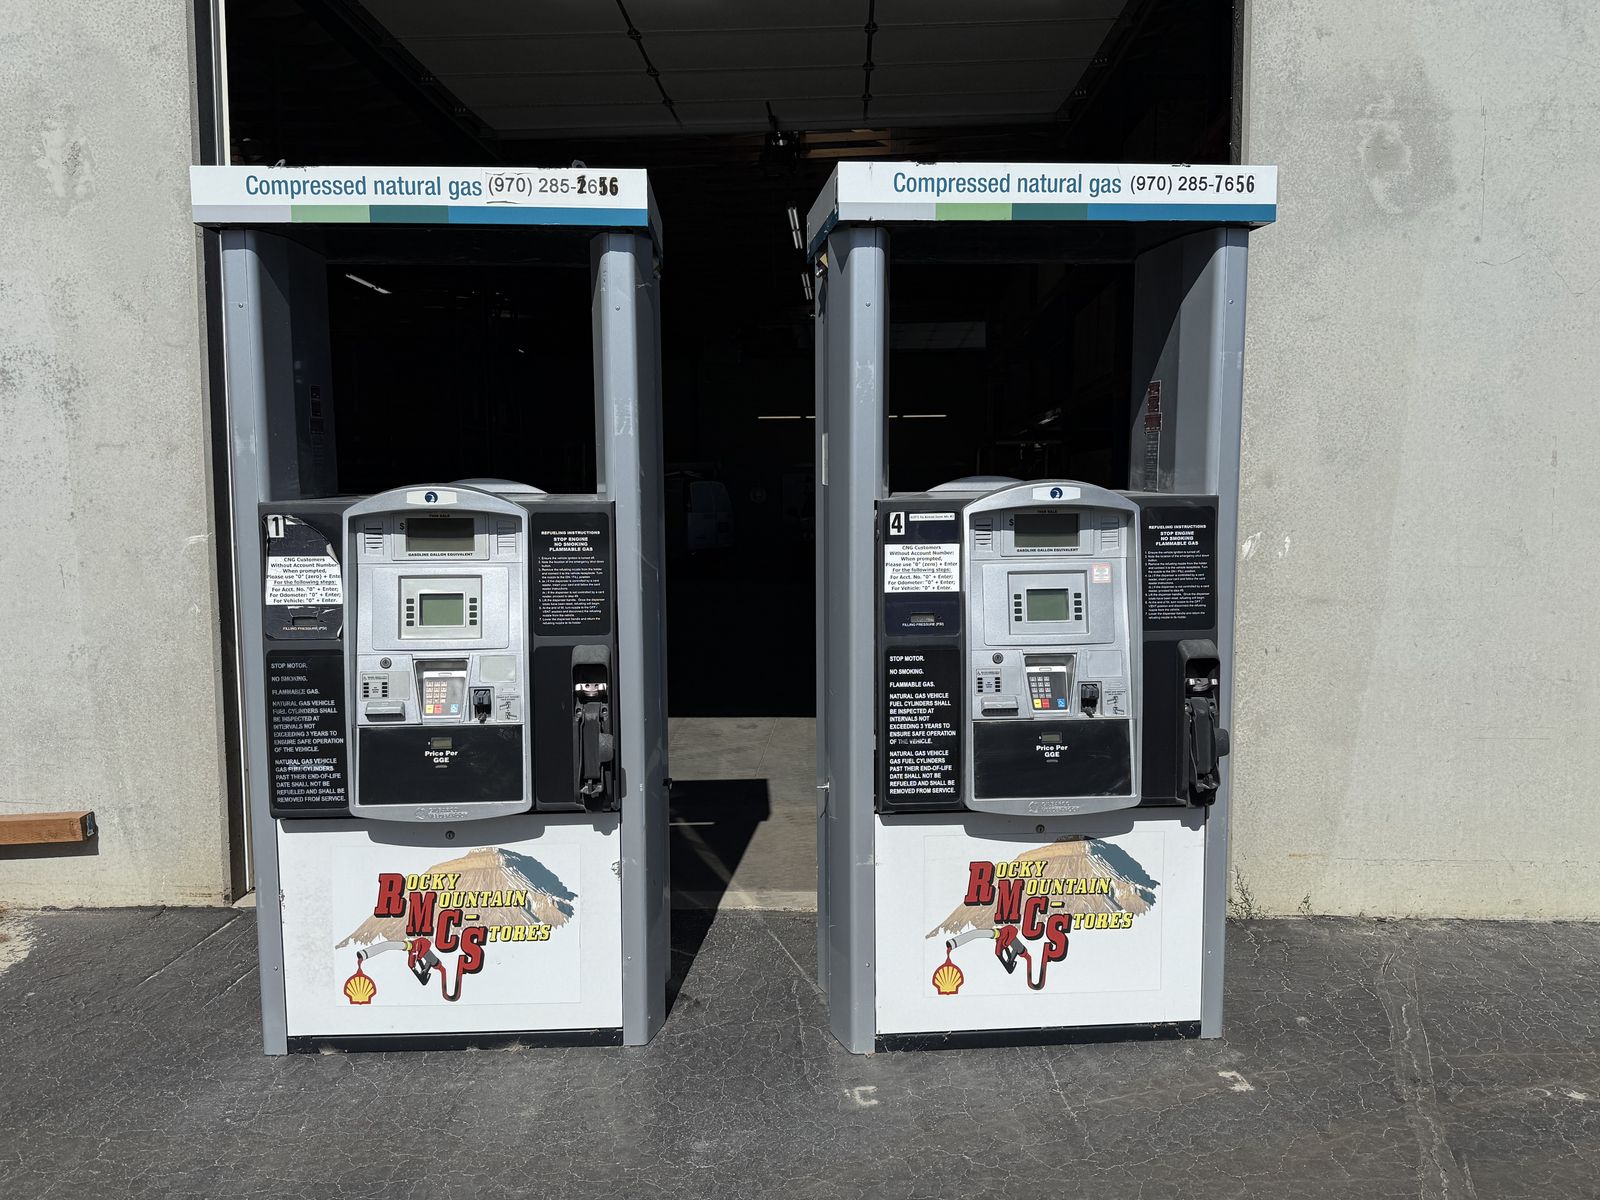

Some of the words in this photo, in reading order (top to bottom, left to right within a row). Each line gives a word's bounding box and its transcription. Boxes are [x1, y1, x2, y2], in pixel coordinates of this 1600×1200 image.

[246, 175, 366, 199] Compressed
[374, 176, 441, 196] natural
[448, 181, 482, 200] gas
[487, 177, 534, 196] (970)
[893, 172, 1011, 197] Compressed
[1017, 174, 1082, 194] natural
[1089, 178, 1121, 198] gas
[1130, 175, 1172, 194] (970)
[1178, 175, 1255, 193] 285-7656
[272, 517, 279, 536] 1
[892, 514, 902, 533] 4
[374, 873, 461, 918] ROCKY
[964, 860, 1048, 906] ROCKY
[994, 877, 1111, 924] MOUNTAIN
[406, 889, 527, 936] MOUNTAIN
